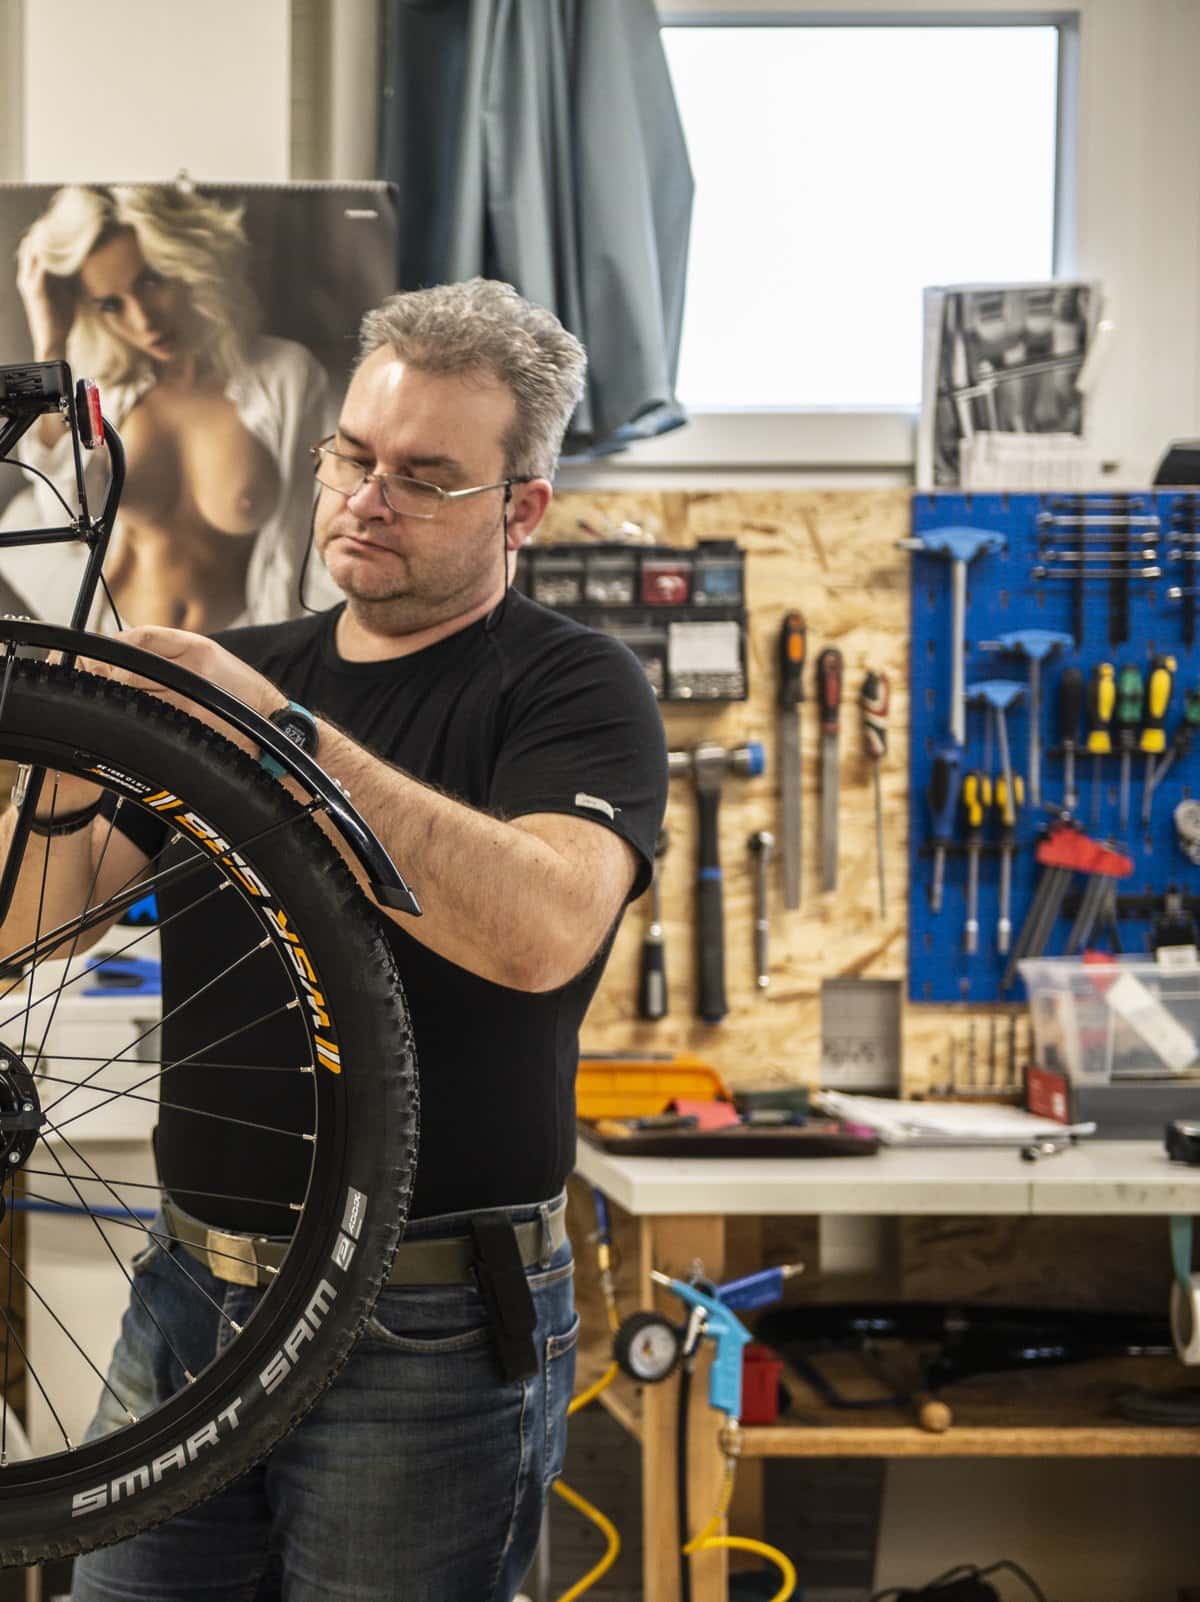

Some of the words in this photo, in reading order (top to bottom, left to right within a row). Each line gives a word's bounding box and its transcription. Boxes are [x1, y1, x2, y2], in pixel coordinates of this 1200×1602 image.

[263, 906, 331, 1030] WSR
[72, 1397, 242, 1518] SMART
[259, 1279, 338, 1395] SAM
